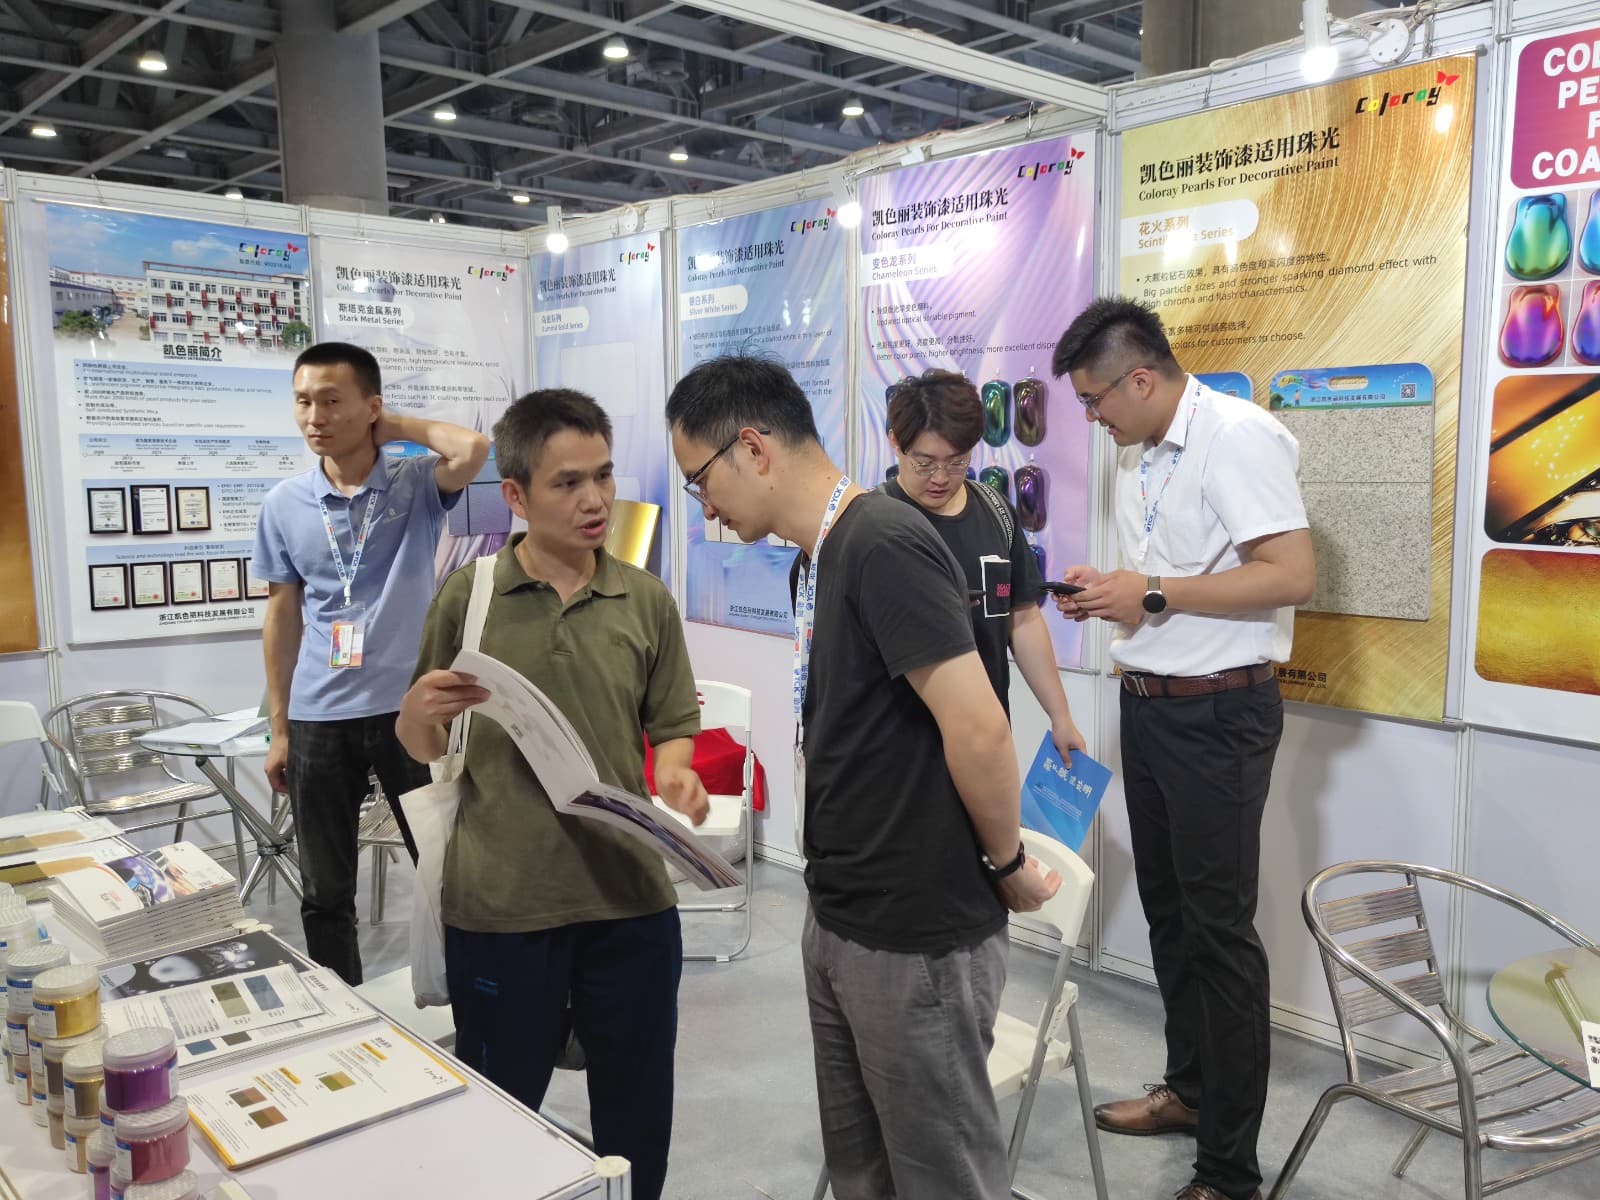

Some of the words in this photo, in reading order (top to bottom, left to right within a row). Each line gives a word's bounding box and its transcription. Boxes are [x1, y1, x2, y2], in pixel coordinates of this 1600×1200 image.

[1355, 86, 1441, 116] Coloray
[1558, 75, 1600, 109] PE
[1140, 126, 1341, 185] 凯色丽装饰漆适用珠光
[1017, 159, 1073, 181] Coloray
[1139, 186, 1178, 202] Coloray
[1181, 180, 1215, 195] Pearls
[1217, 174, 1237, 188] For
[1239, 164, 1303, 184] Decorative
[1306, 156, 1340, 173] Paint
[872, 187, 1009, 227] 凯色丽装饰漆适用珠光
[790, 218, 829, 235] Coloray
[871, 229, 899, 241] Coloray
[901, 225, 925, 237] Pearls
[926, 221, 940, 233] For
[941, 215, 984, 230] Decorative
[986, 211, 1008, 223] Paint
[1139, 216, 1189, 235] 花火系列
[239, 242, 290, 261] Coloray
[872, 252, 917, 270] 变色龙系列
[468, 265, 508, 282] Coloray
[872, 267, 913, 281] Chameleon
[1143, 287, 1157, 297] Big
[1160, 284, 1192, 296] particle
[1195, 281, 1215, 292] sizes
[1219, 279, 1236, 289] and
[1239, 274, 1278, 287] stronger
[1282, 269, 1324, 284] sparking
[1328, 262, 1374, 277] diamond
[1379, 259, 1409, 271] effect
[1413, 254, 1437, 266] with
[1163, 296, 1195, 306] chroma
[1198, 293, 1214, 303] and
[1216, 290, 1238, 301] flash
[339, 314, 358, 322] Stark
[360, 316, 381, 324] Metal
[383, 317, 404, 325] Series
[163, 345, 222, 358] 凯色丽简介
[1004, 342, 1035, 352] excellent
[1036, 341, 1057, 351] dispe
[1197, 338, 1210, 348] for
[833, 488, 843, 503] YCK
[807, 584, 815, 603] YCK
[1274, 667, 1327, 683] 展有限公司
